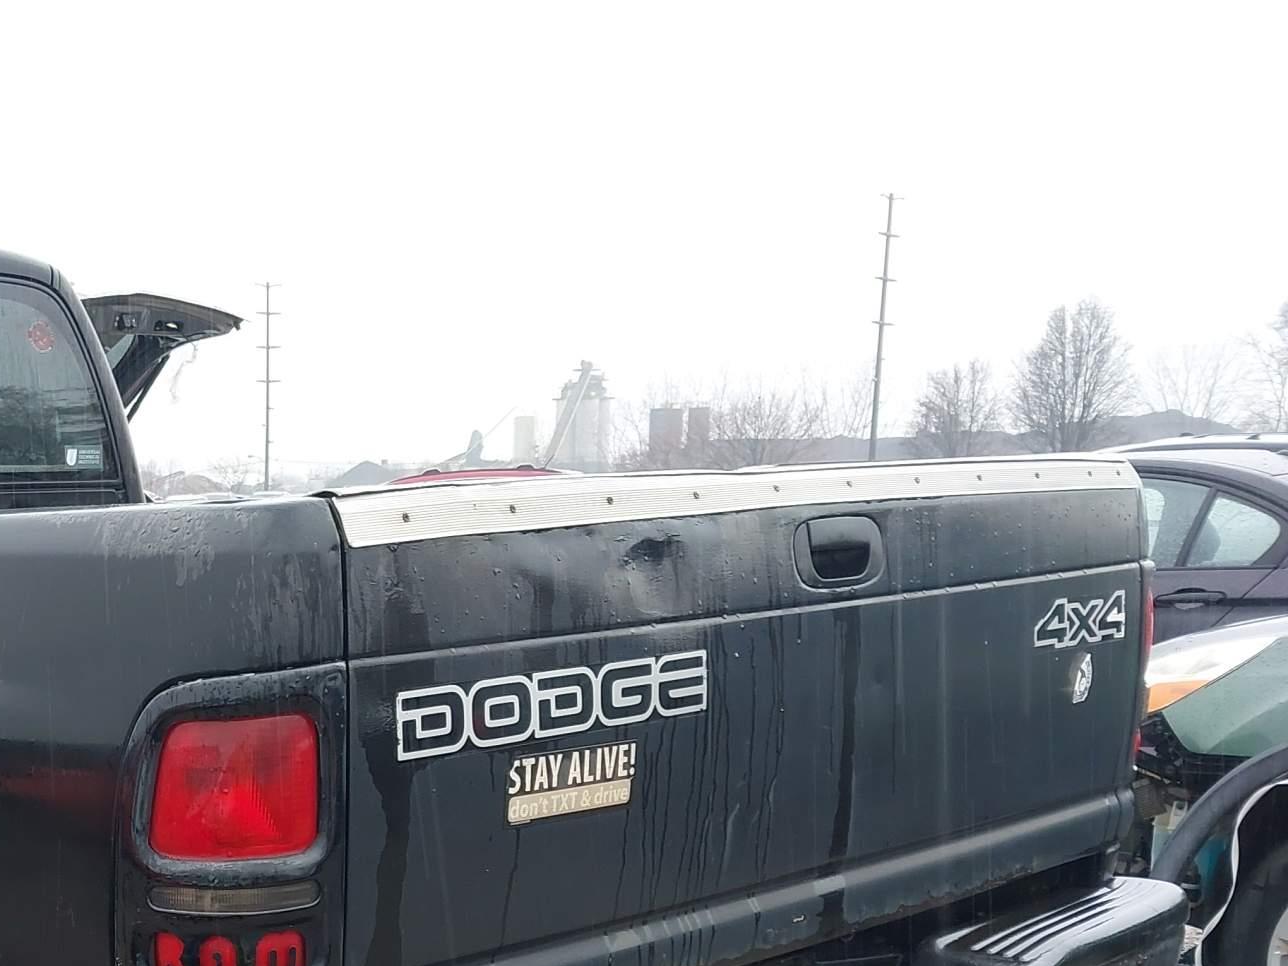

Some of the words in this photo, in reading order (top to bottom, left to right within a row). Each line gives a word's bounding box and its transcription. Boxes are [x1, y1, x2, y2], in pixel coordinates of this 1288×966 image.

[396, 649, 708, 762] DODGE
[508, 754, 561, 796] STAY
[567, 742, 637, 787] ALIVE!
[509, 795, 550, 822] don't
[550, 791, 579, 814] TXT
[579, 791, 592, 807] &
[592, 786, 629, 811] drive
